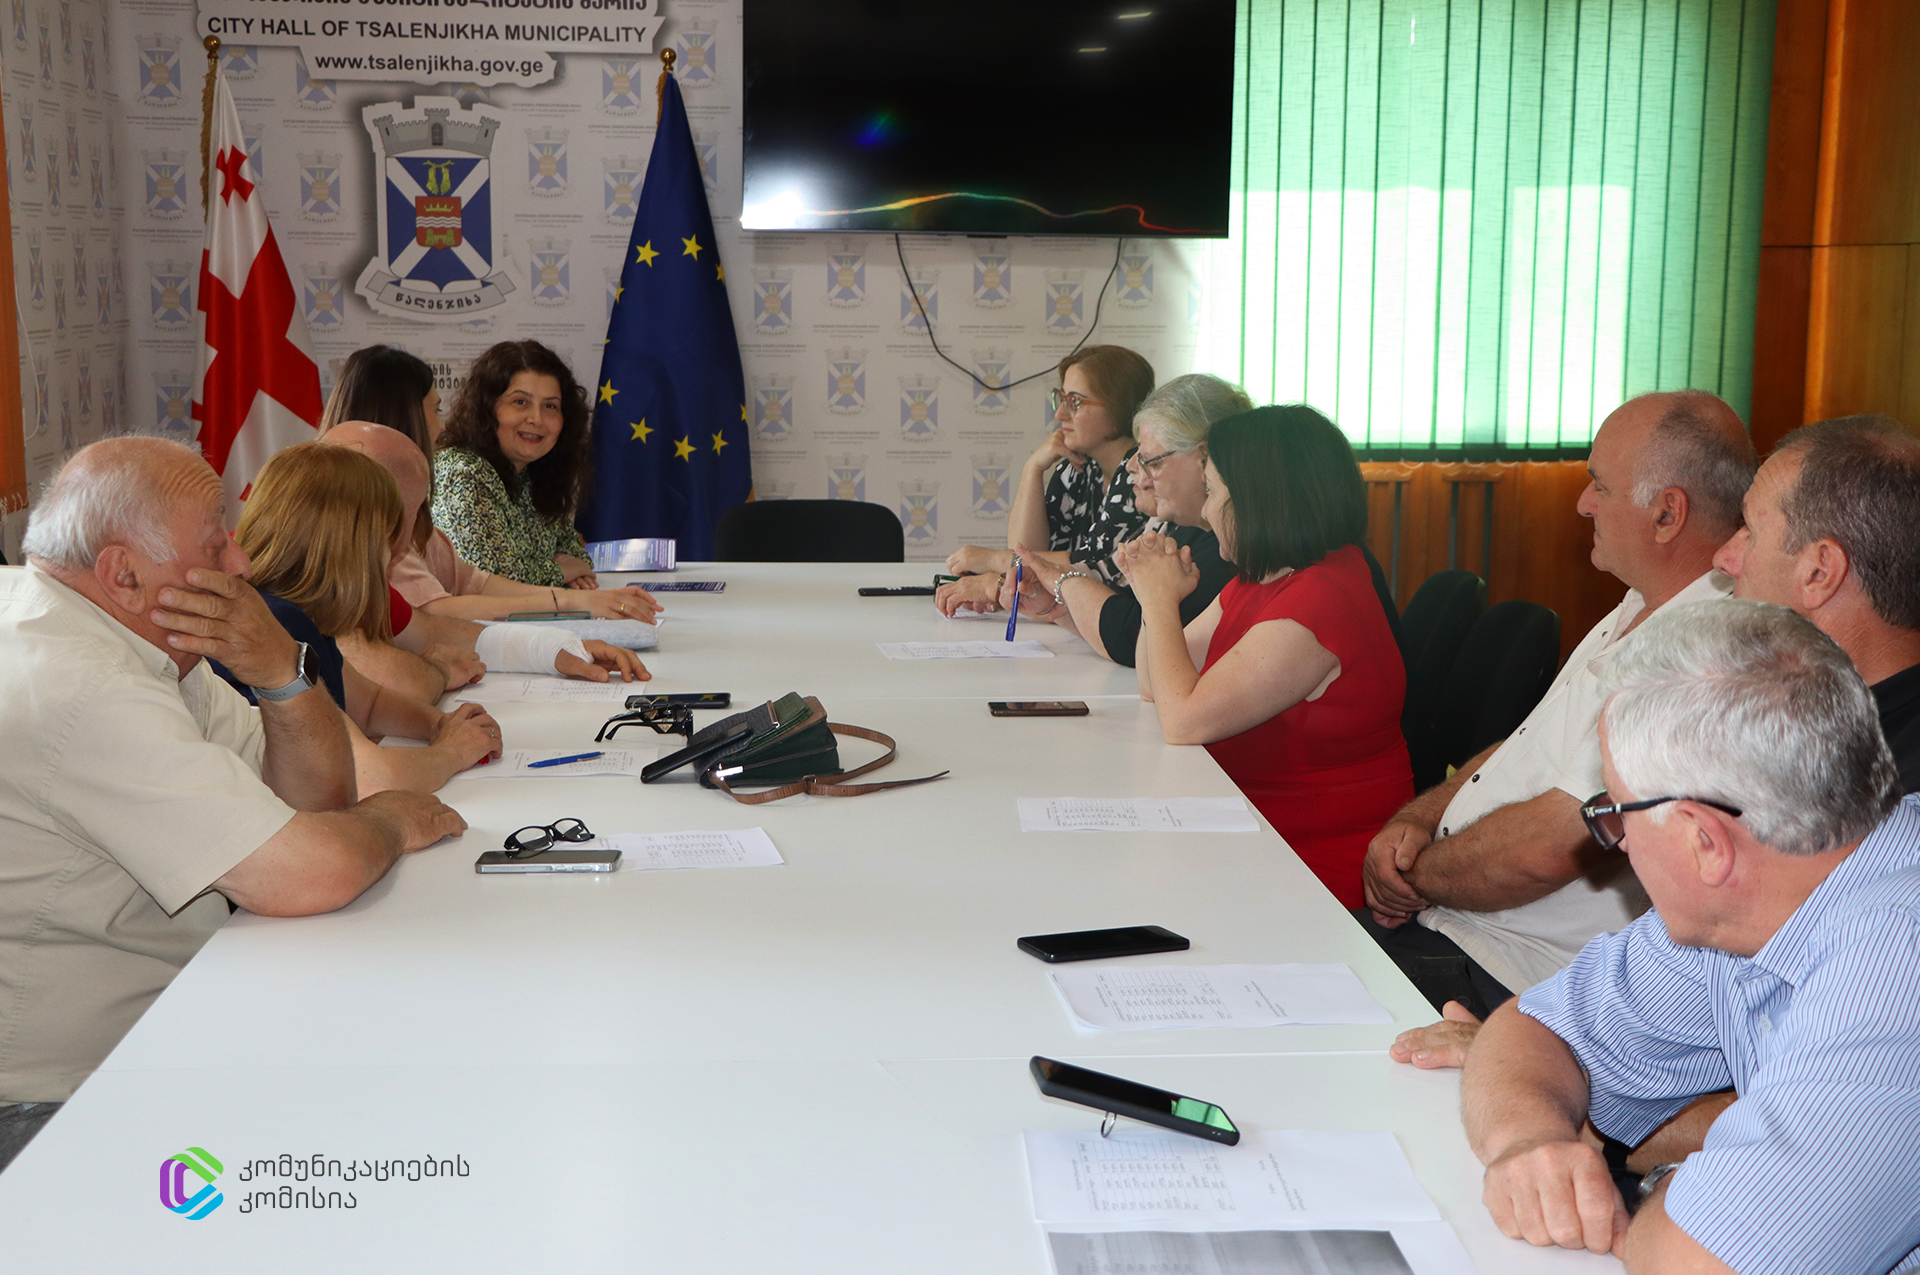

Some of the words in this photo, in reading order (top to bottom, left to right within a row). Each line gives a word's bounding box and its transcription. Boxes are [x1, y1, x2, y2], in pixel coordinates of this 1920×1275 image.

[207, 17, 255, 35] CITY
[261, 18, 316, 37] HALL
[321, 19, 350, 37] OF
[355, 21, 500, 40] TSALENJIKHA
[505, 24, 647, 43] MUNICIPALITY
[314, 54, 544, 77] www.tsalenjikha.gov.ge
[395, 292, 482, 310] წალენჯიხა
